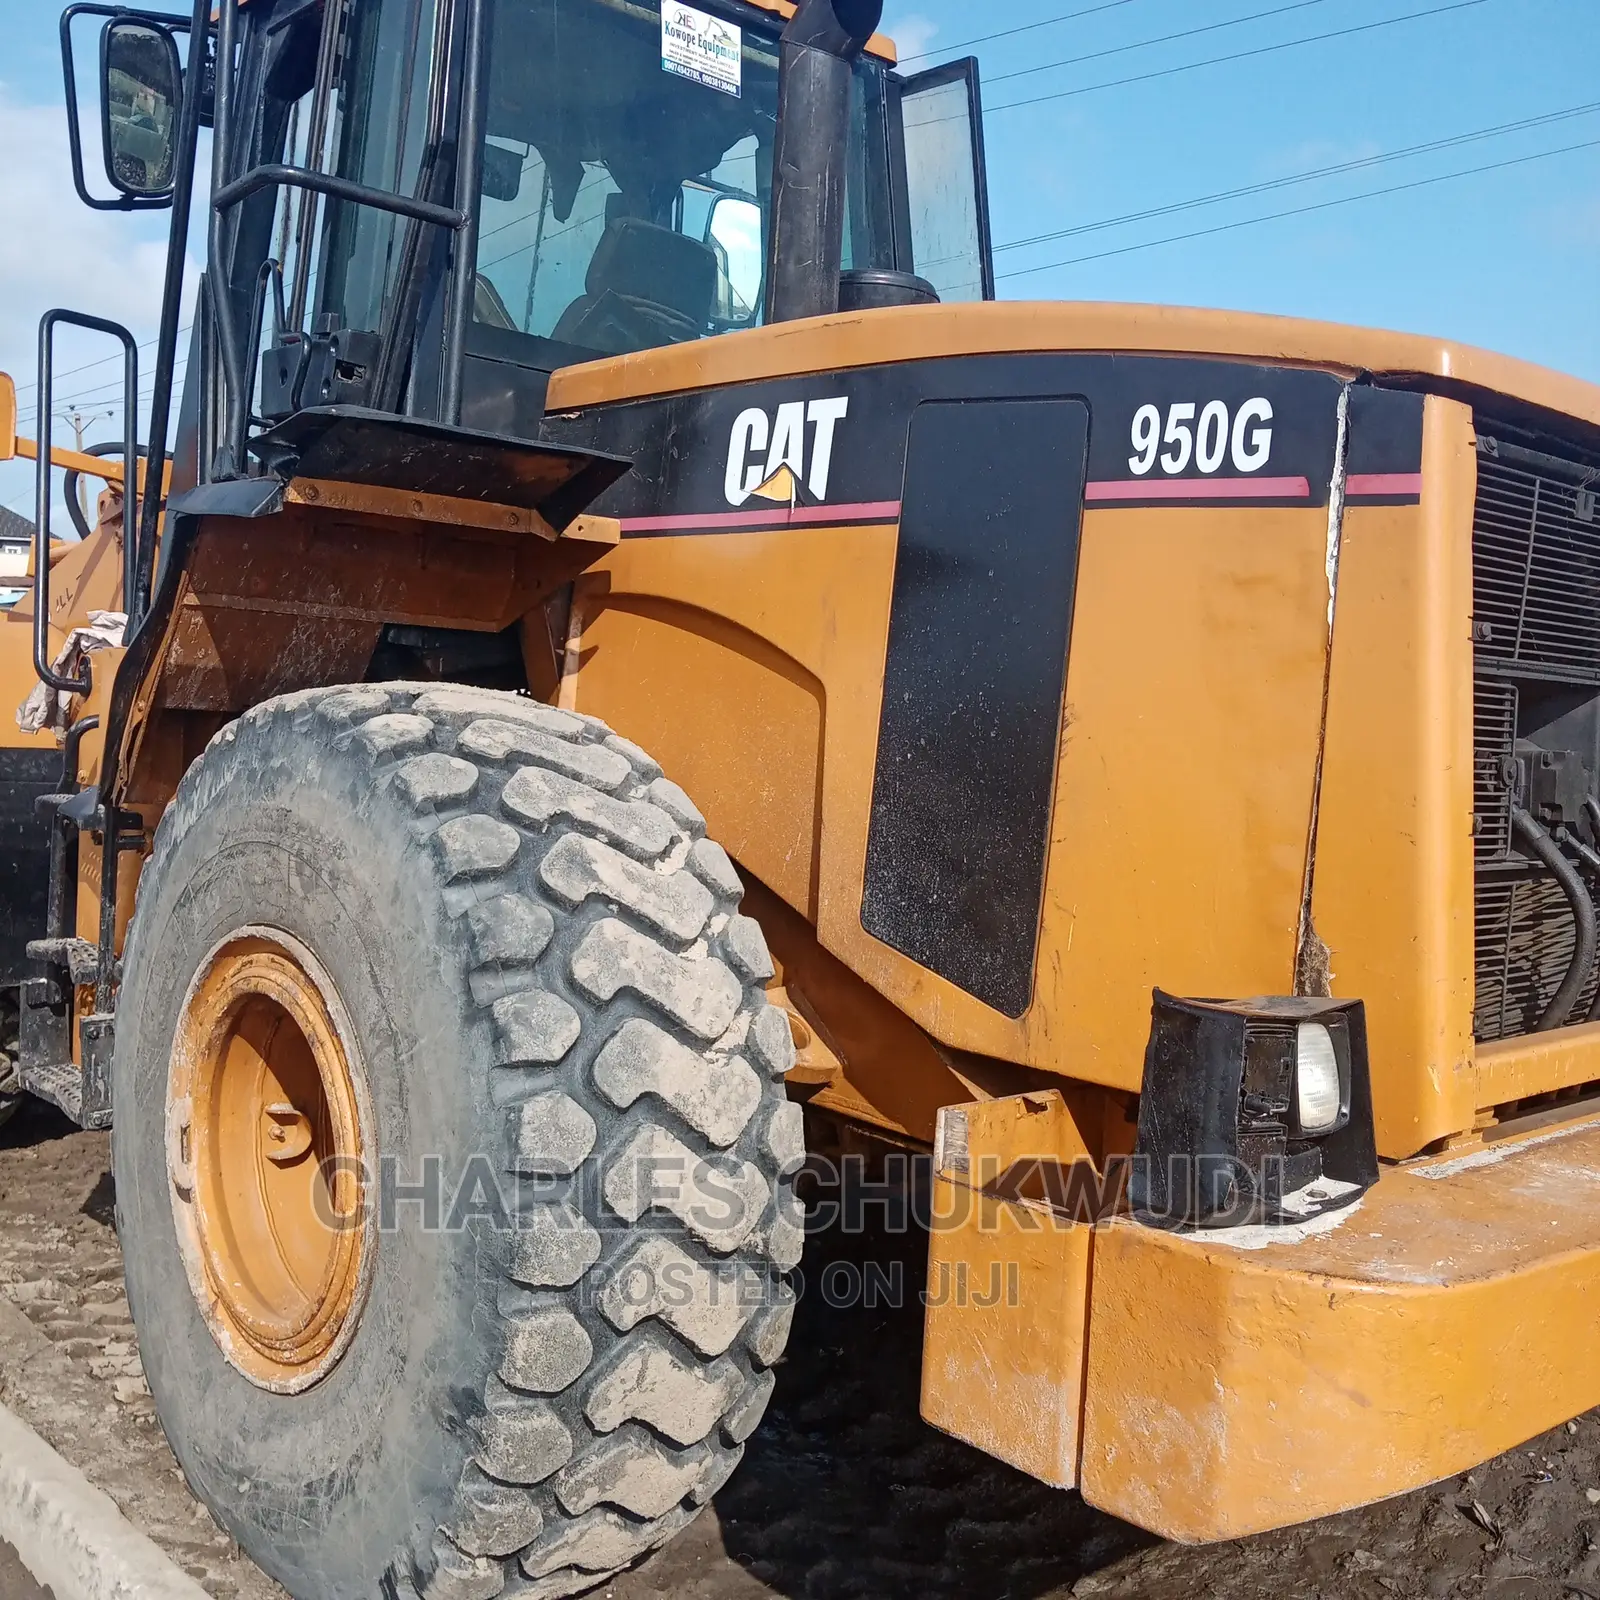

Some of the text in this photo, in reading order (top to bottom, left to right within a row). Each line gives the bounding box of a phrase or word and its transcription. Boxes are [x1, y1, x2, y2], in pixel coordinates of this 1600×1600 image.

[664, 20, 696, 48] Kowope
[697, 33, 740, 62] Equipment
[724, 396, 849, 507] CAT
[1128, 396, 1274, 476] 950G
